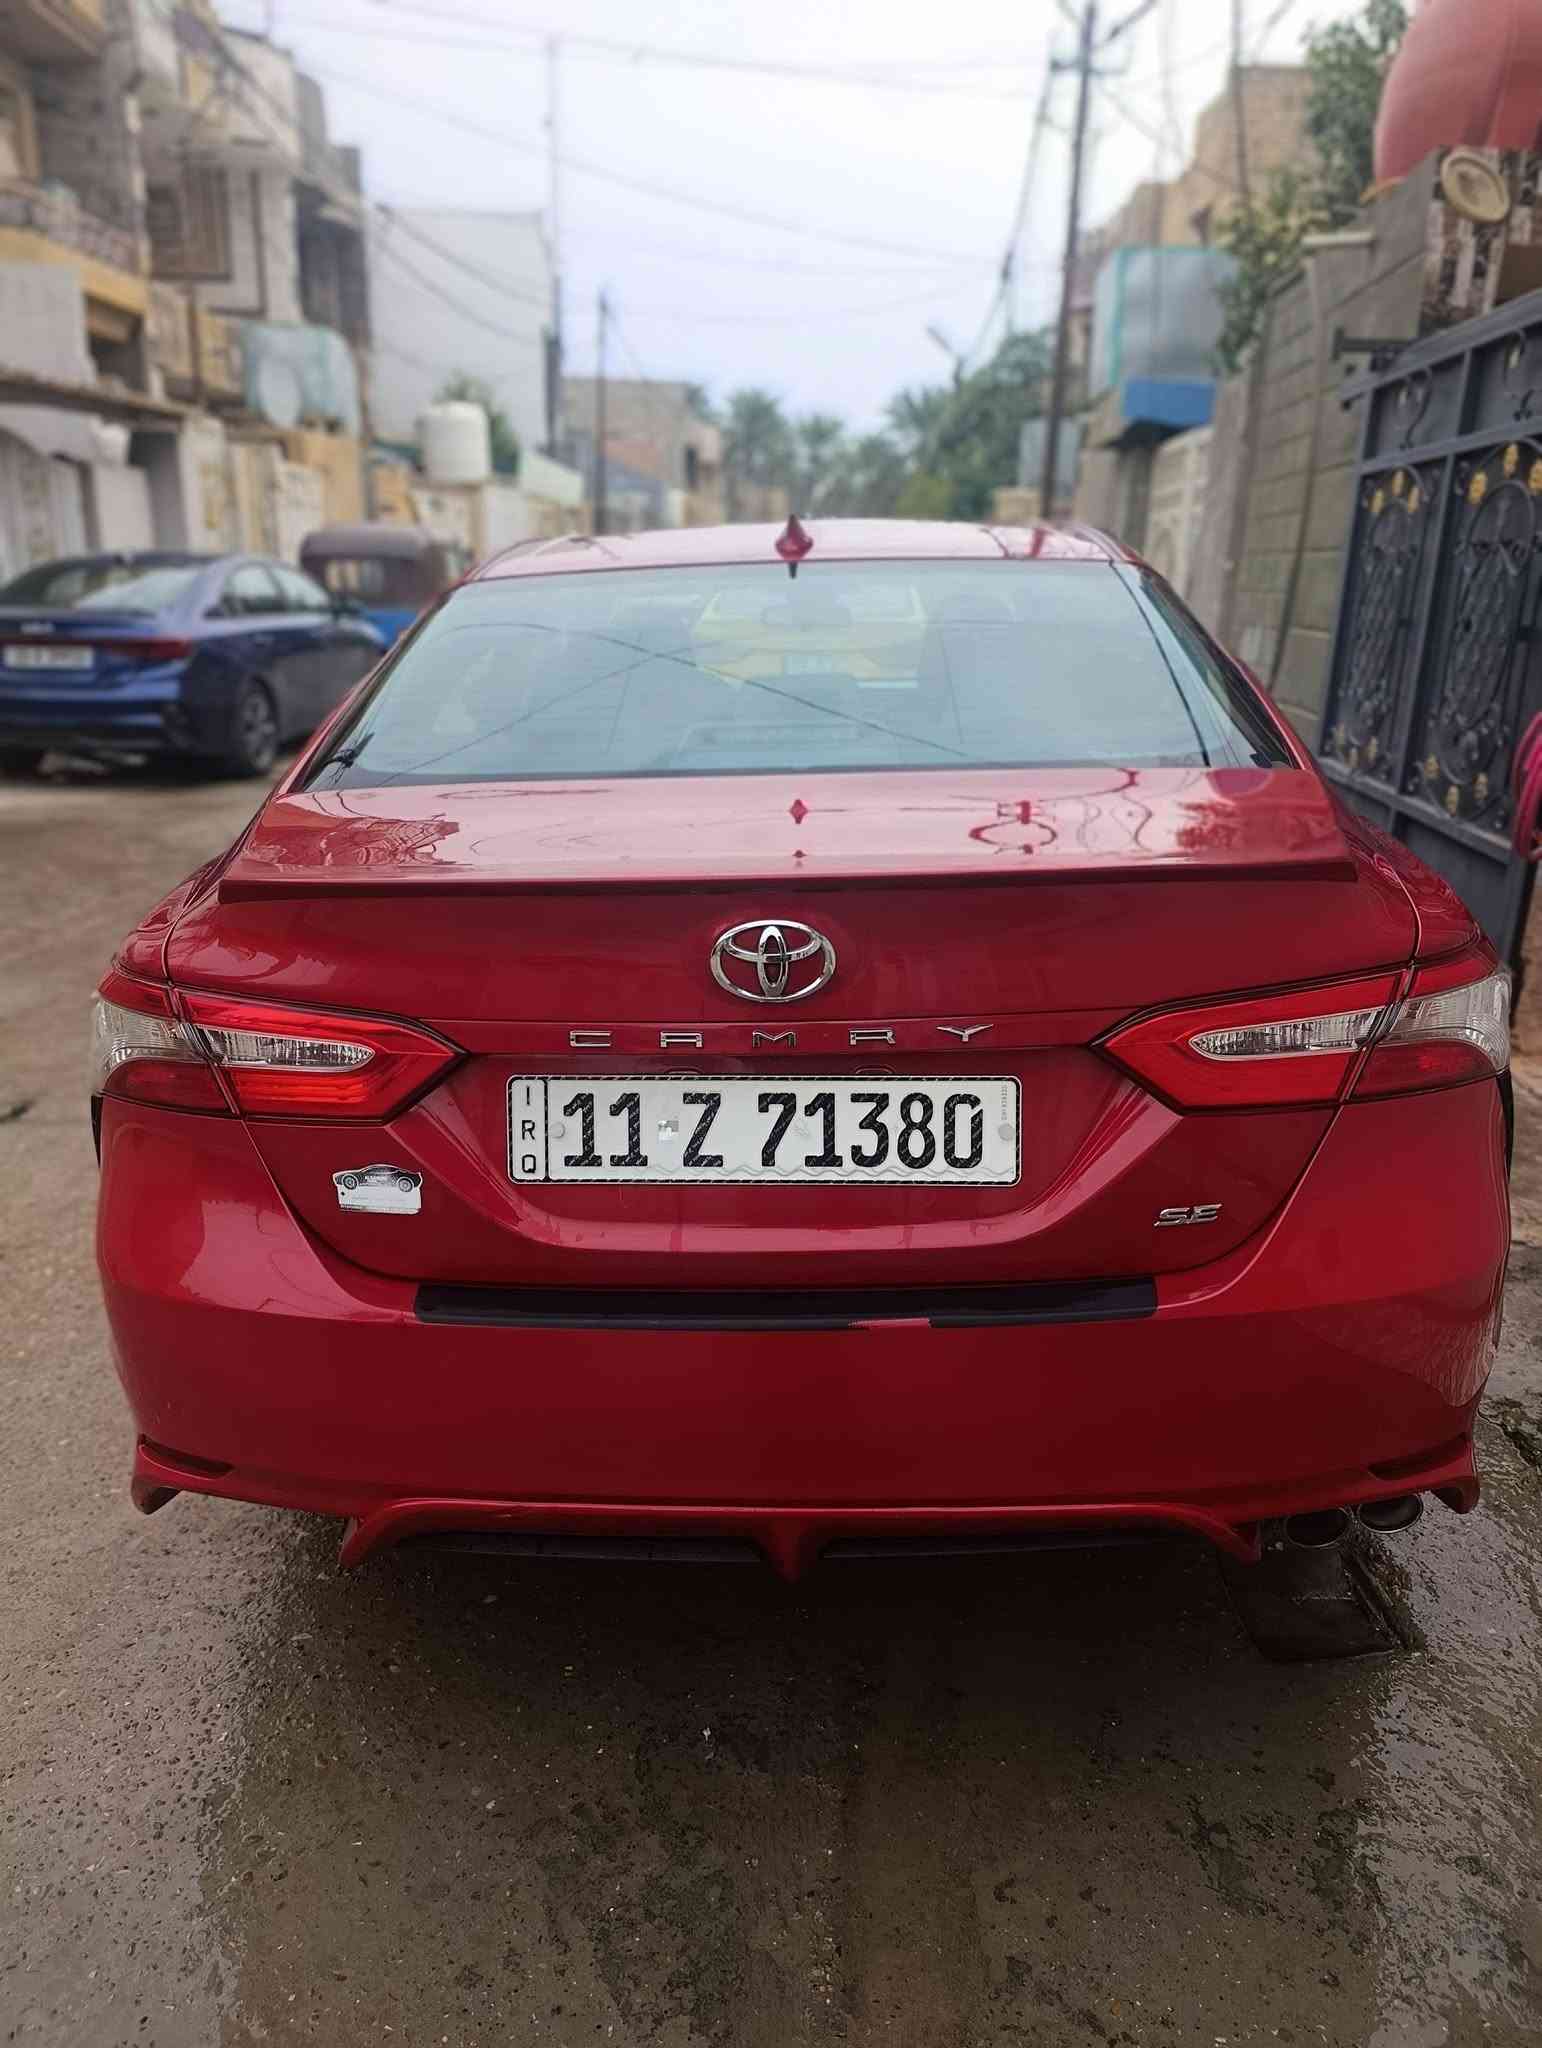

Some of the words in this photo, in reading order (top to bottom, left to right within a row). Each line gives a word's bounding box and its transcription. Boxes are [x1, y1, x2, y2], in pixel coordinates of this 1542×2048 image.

[569, 1023, 994, 1048] CAMRY
[521, 1085, 537, 1174] IRQ
[563, 1092, 648, 1167] 11
[682, 1092, 724, 1167] Z
[757, 1092, 984, 1169] 71380
[1153, 1203, 1222, 1226] SE
